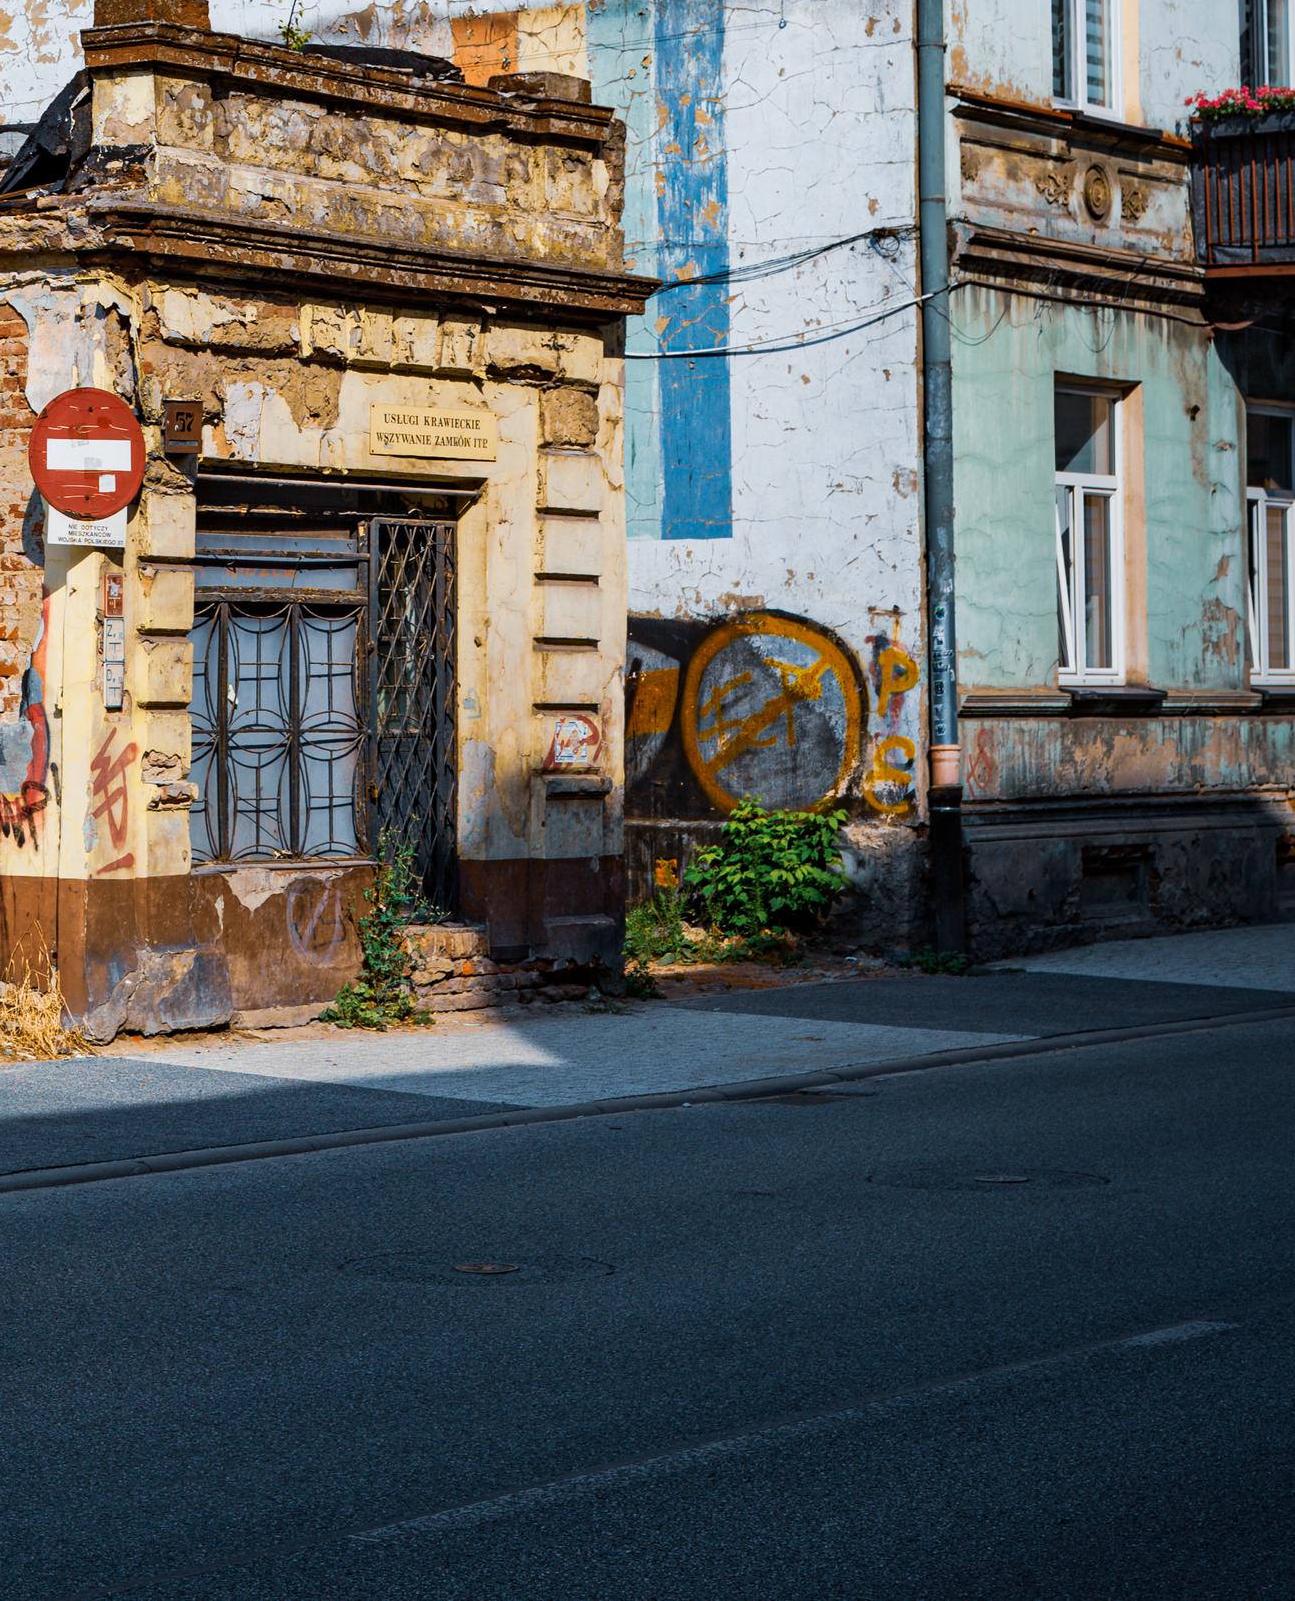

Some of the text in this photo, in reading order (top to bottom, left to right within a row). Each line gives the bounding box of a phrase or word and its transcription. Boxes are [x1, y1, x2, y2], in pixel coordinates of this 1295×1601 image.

[384, 413, 480, 430] USŁUGI KRAWIECKIE
[376, 432, 432, 446] WSZYWANIE
